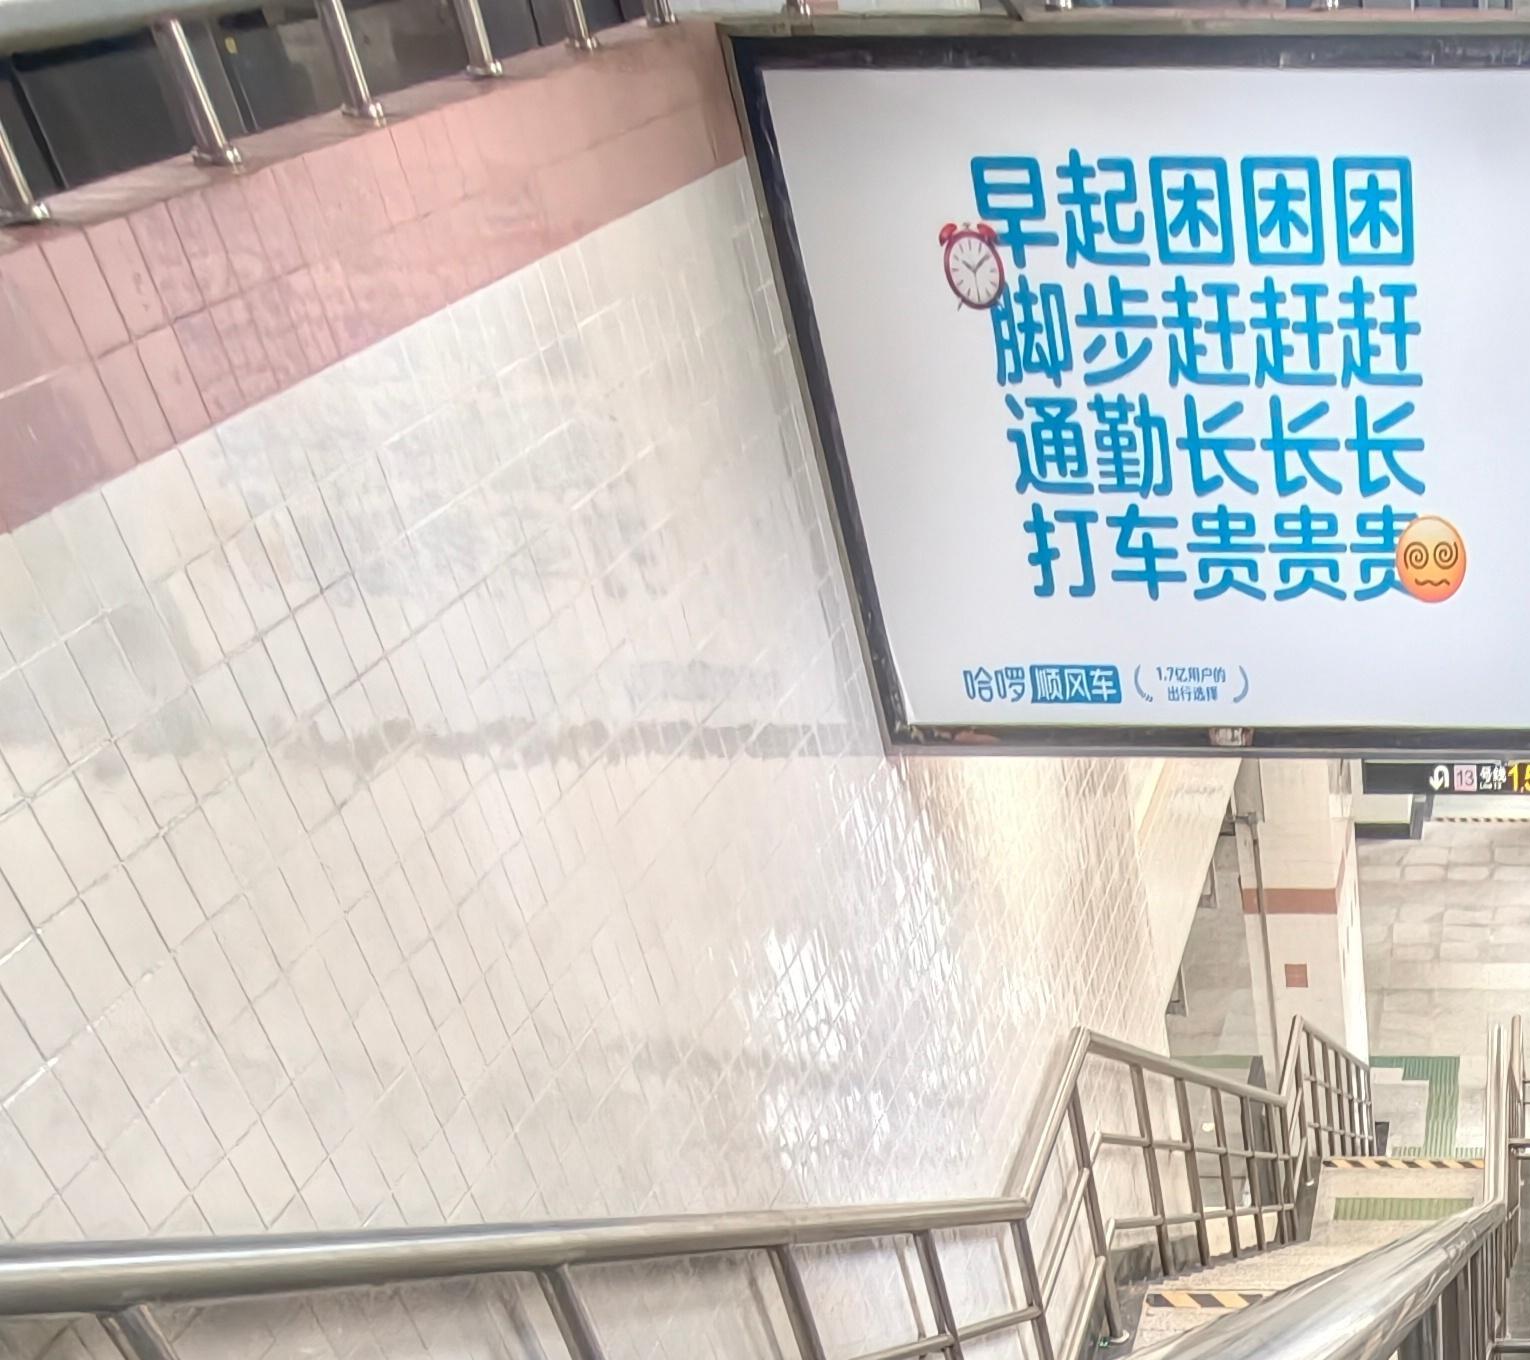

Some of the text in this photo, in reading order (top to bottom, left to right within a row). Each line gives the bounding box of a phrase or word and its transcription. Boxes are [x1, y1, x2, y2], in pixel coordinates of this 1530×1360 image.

[970, 148, 1416, 268] 早起困困困
[990, 275, 1424, 389] 脚步赶赶赶
[1004, 393, 1427, 499] 通勤长长长
[1023, 502, 1419, 602] 打车贵贵贵
